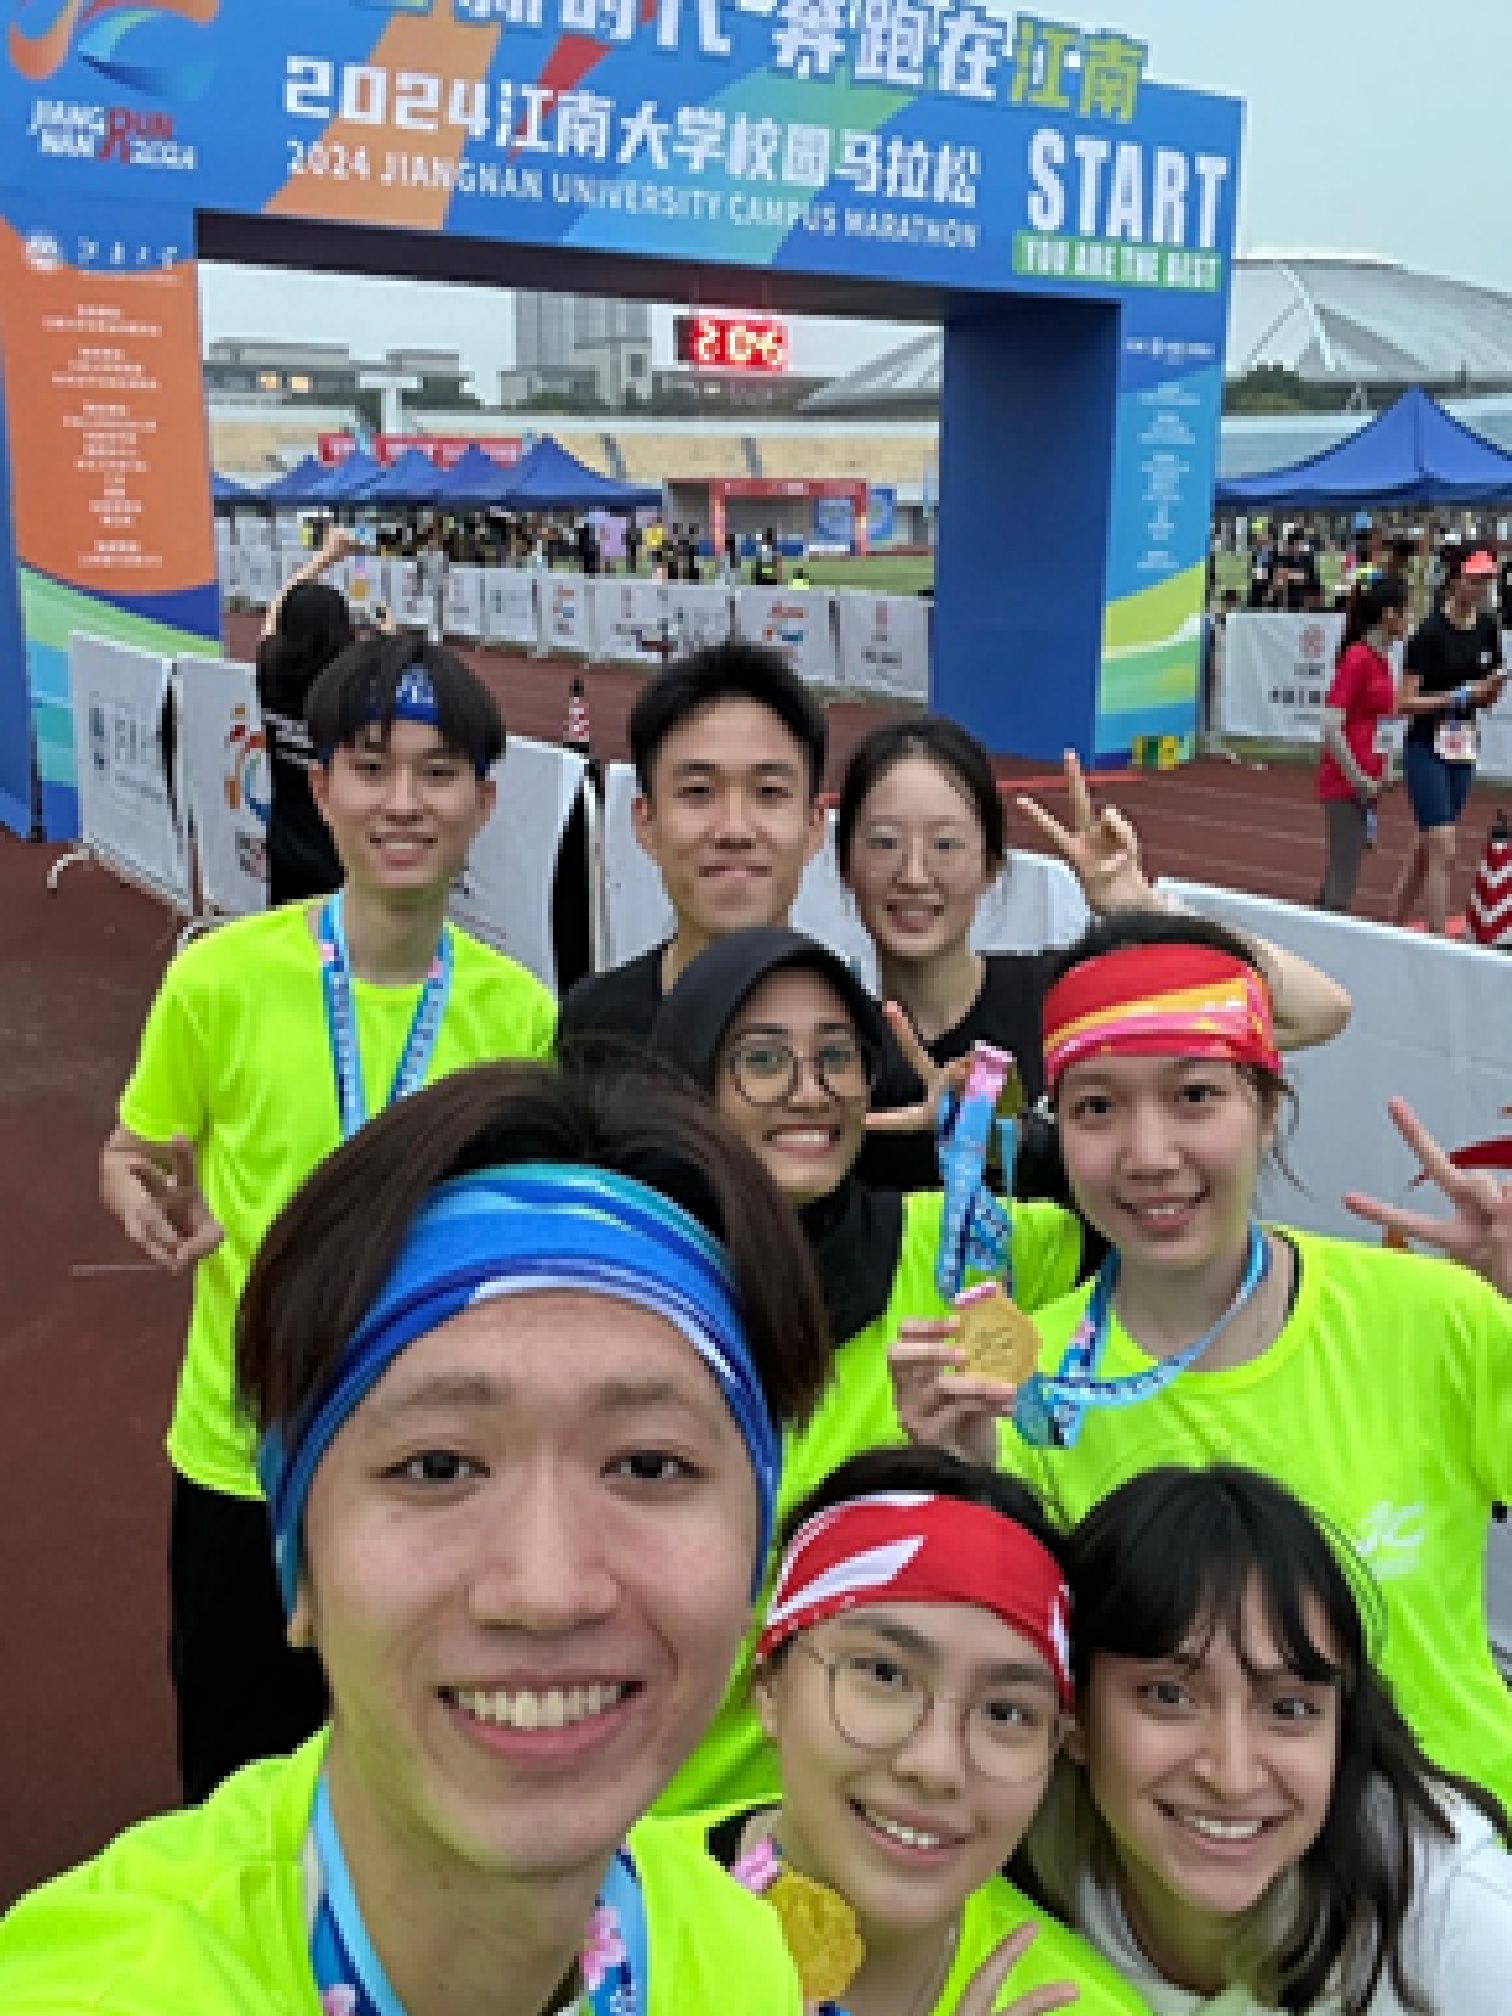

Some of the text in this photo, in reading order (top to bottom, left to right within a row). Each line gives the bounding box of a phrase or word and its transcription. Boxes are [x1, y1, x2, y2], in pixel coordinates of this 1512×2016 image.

[286, 139, 977, 251] 2024 JIANGNAN UNIVERSITY CAMPUS MARATHON
[1027, 128, 1228, 249] START
